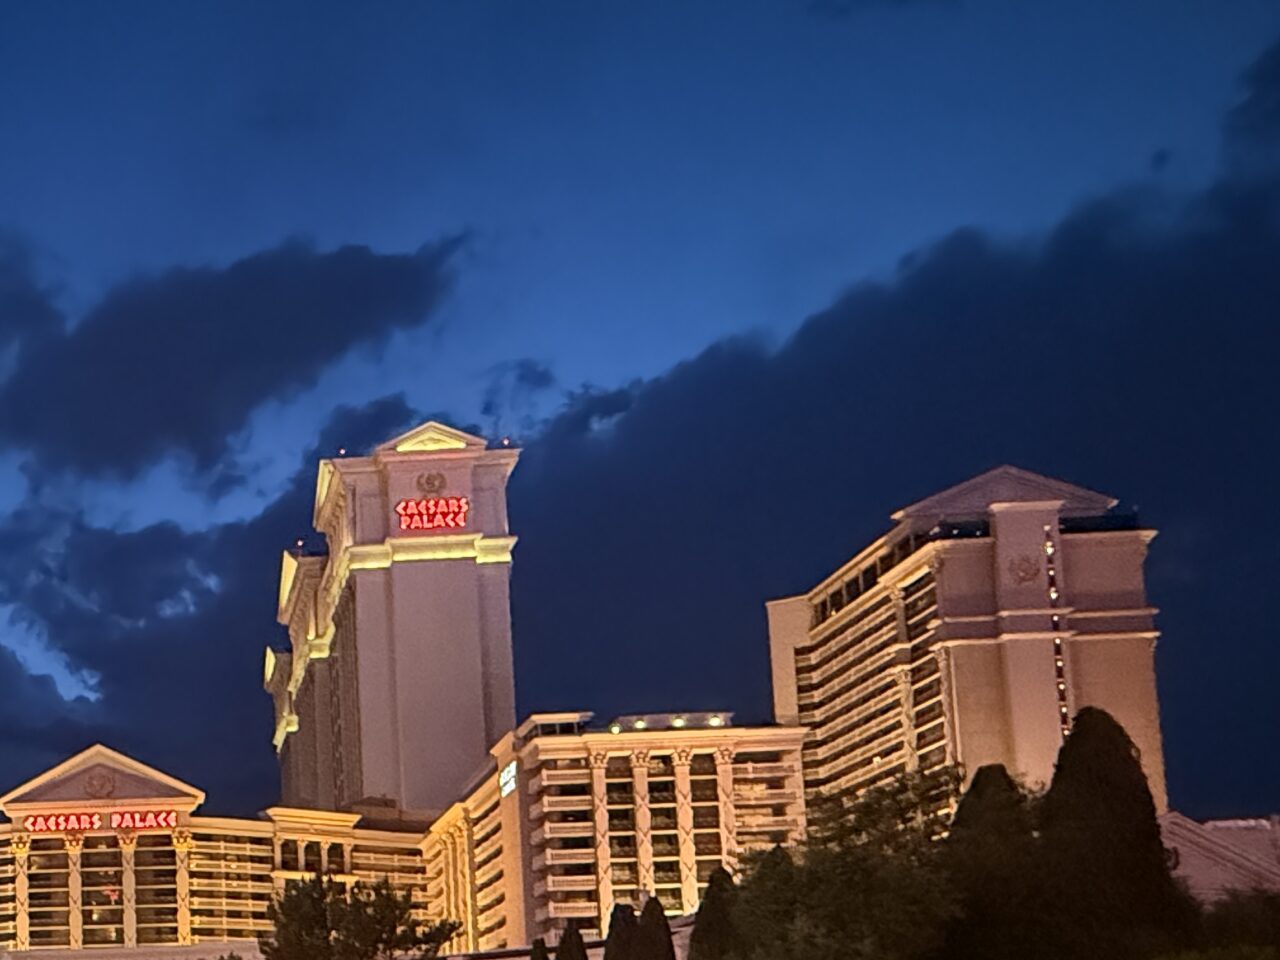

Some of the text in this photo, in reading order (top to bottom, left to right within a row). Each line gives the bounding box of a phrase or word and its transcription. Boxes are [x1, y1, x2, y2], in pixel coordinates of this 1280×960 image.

[396, 497, 469, 516] CAESARS
[400, 512, 466, 530] PALACE
[24, 811, 178, 832] CAESARS PALACE
